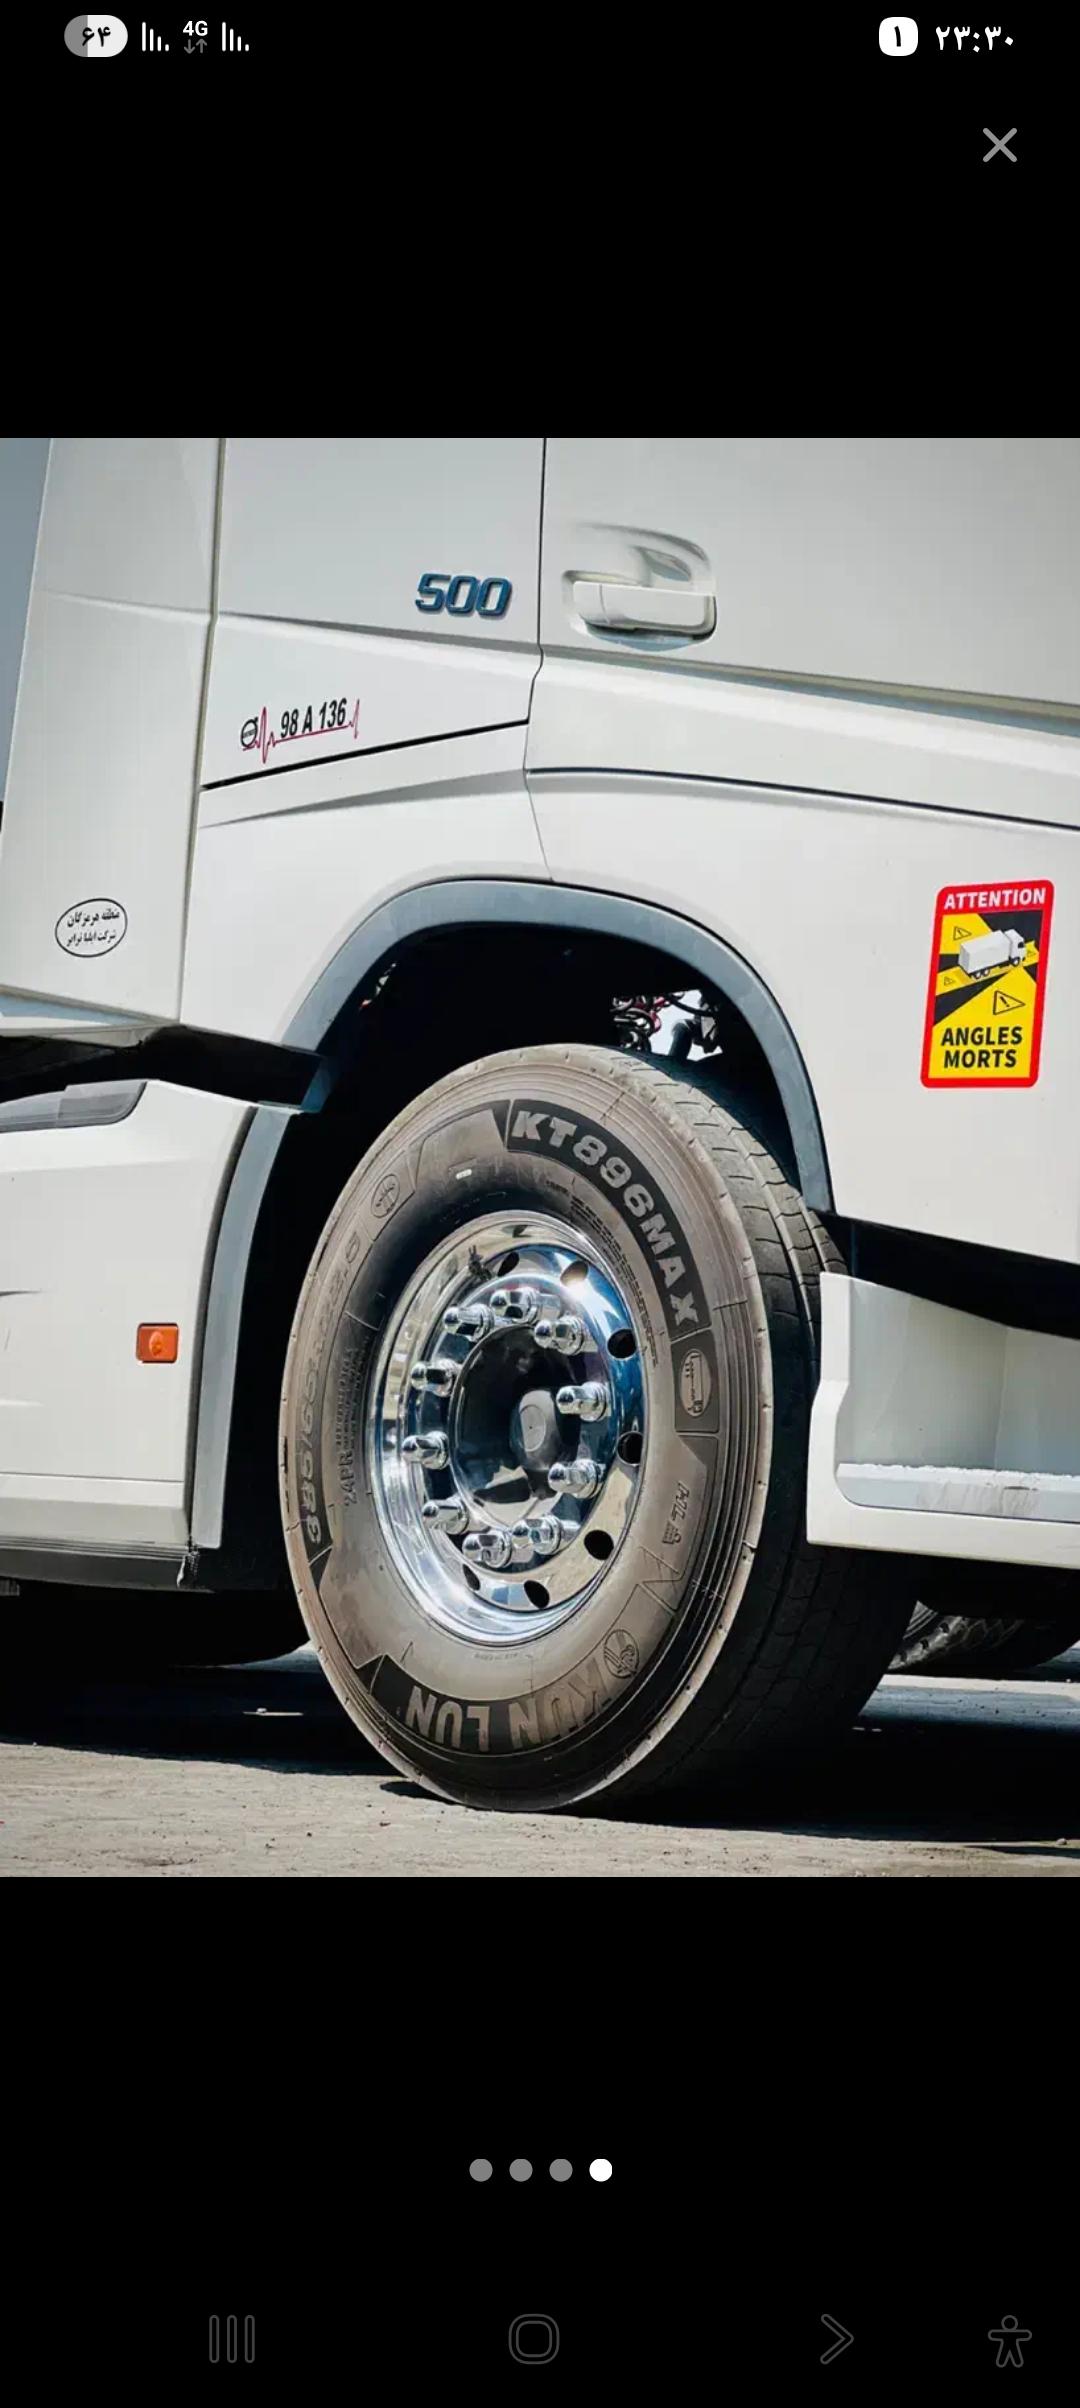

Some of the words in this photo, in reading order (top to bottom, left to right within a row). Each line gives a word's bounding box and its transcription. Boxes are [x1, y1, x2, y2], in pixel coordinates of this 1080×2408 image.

[415, 573, 513, 620] 500
[280, 708, 300, 738] 98
[301, 704, 313, 734] A
[319, 697, 347, 730] 136
[943, 886, 1046, 909] ATTENTION
[941, 1026, 1023, 1047] ANGLES
[943, 1049, 1017, 1069] MORTS
[511, 1110, 700, 1328] KT896MAX
[336, 1448, 358, 1508] 24PR
[404, 1684, 492, 1753] LUN
[507, 1656, 616, 1747] KUN
